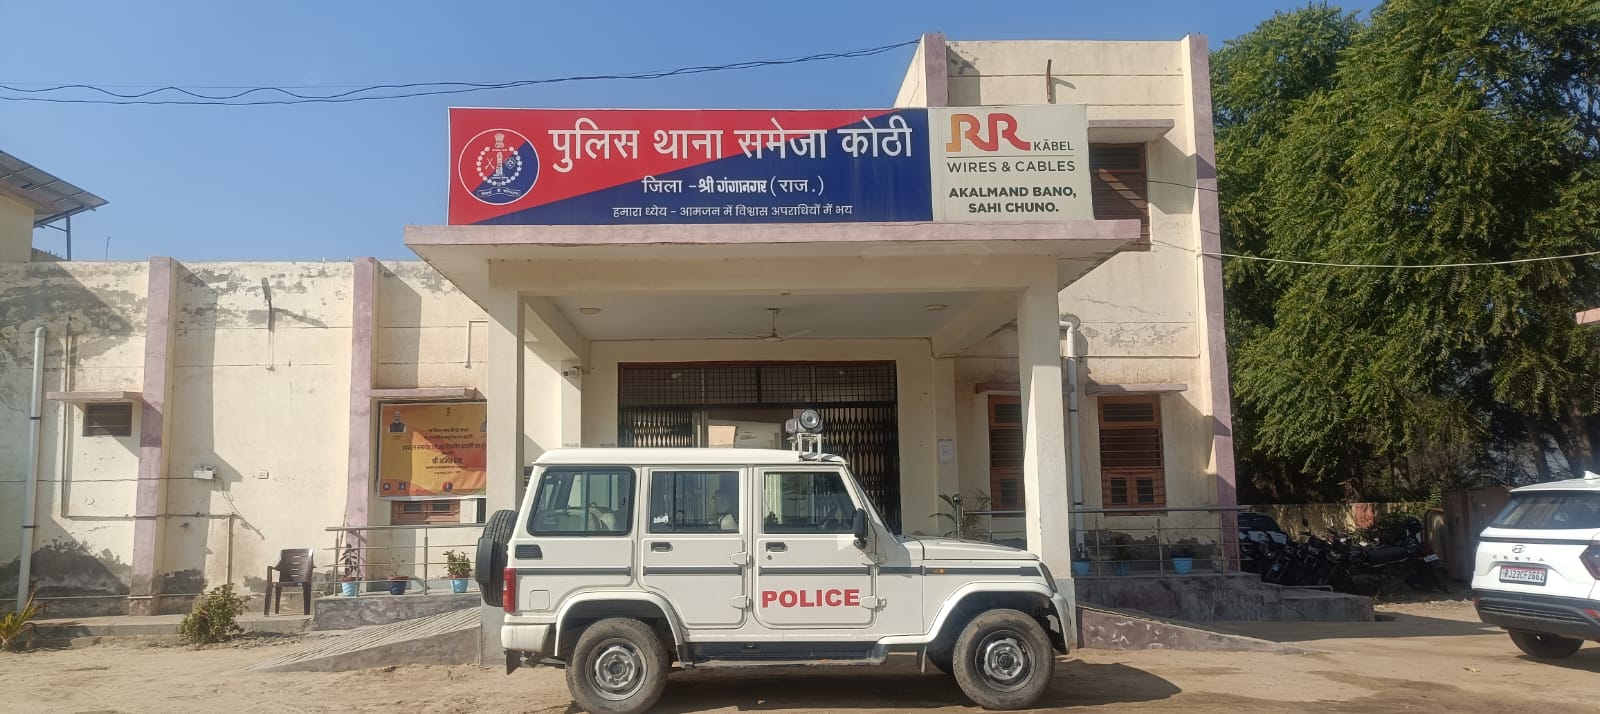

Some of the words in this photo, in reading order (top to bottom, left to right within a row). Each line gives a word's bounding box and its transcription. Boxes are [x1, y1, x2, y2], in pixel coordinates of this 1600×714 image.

[945, 113, 1031, 152] RR
[548, 117, 640, 173] पुलिस
[653, 128, 723, 160] थाना
[734, 117, 828, 159] समेजा
[837, 115, 913, 158] कोठी
[947, 162, 997, 173] WIRES
[1001, 161, 1011, 172] &
[1015, 161, 1076, 172] CABLES
[641, 175, 682, 193] जिला
[717, 176, 767, 193] गंगानगर
[949, 187, 1029, 198] AKALMAND
[1032, 186, 1077, 198] BANO,
[612, 206, 642, 218] हमारा
[645, 206, 667, 218] ध्येय
[679, 206, 719, 217] आमजन
[723, 204, 732, 217] में
[735, 204, 768, 217] विश्वास
[771, 203, 821, 216] अपराधियों
[823, 203, 832, 215] में
[835, 205, 852, 215] भय
[968, 203, 1001, 213] SAHI
[1005, 202, 1059, 213] CHUNO.
[1492, 554, 1545, 562] CRETA
[762, 589, 860, 608] POLICE
